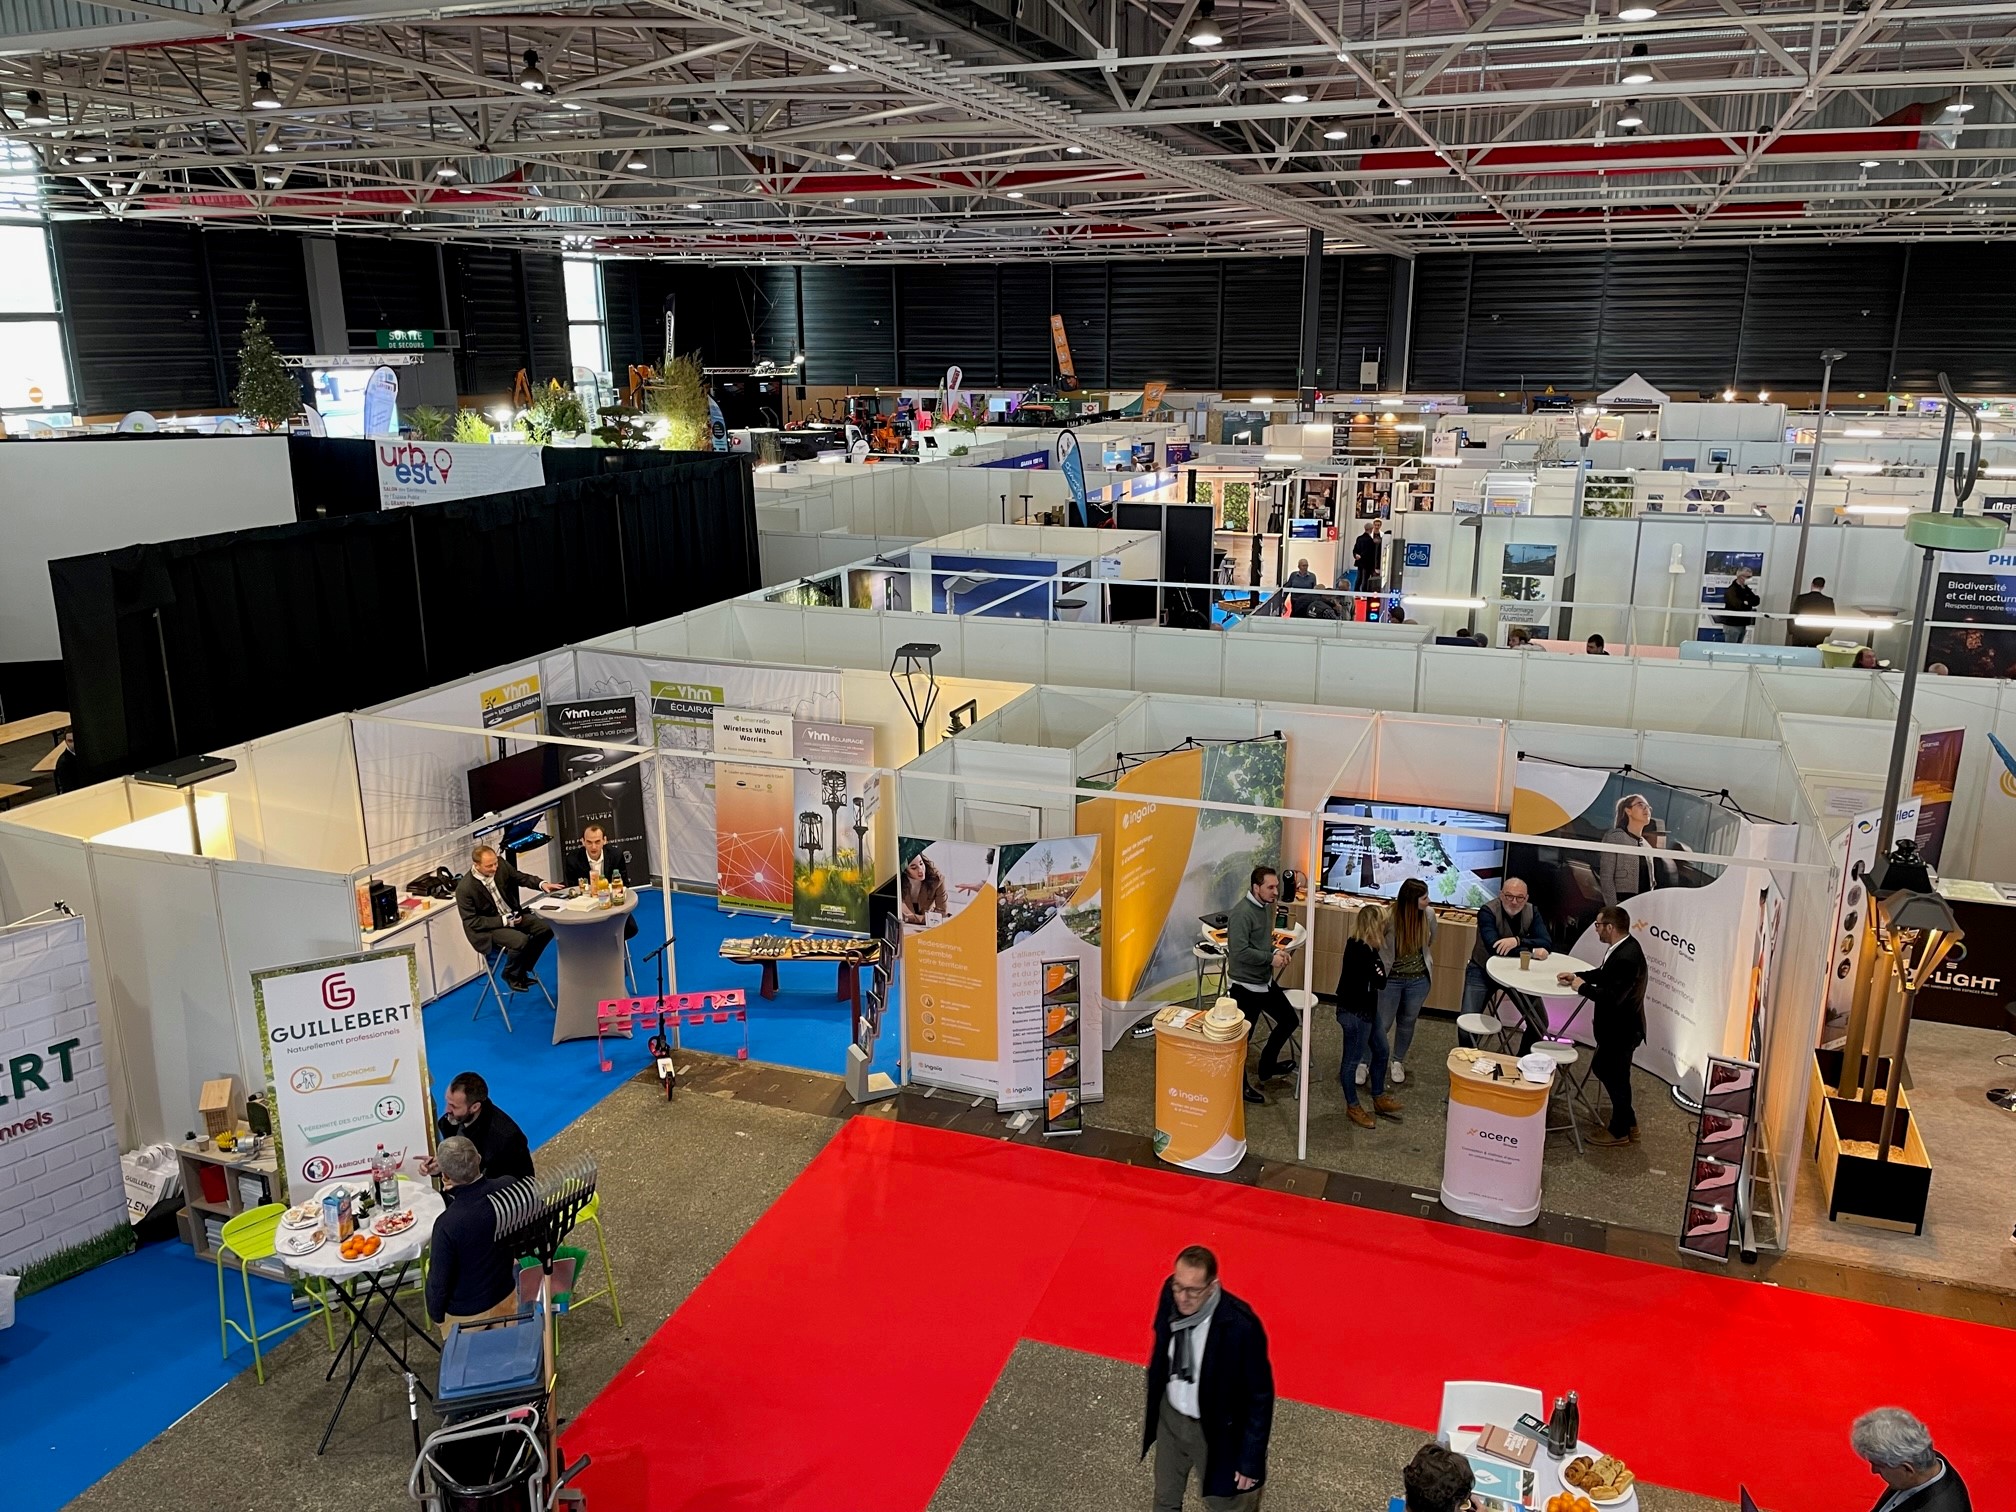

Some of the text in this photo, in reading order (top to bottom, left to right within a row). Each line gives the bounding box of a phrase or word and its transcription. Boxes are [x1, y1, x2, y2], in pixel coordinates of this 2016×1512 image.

[389, 331, 423, 341] SORTIE
[380, 442, 427, 467] urb
[395, 463, 437, 485] est
[1948, 580, 2007, 592] Biodiversité
[1946, 592, 1957, 600] et
[1959, 593, 1976, 601] ciel
[1945, 602, 1985, 610] Respectons
[502, 681, 531, 699] vhm
[677, 685, 712, 701] vhm
[498, 696, 540, 715] MOBILIER URBAIN
[564, 707, 627, 719] vhm ÉCLAIRAGE
[723, 724, 783, 736] Wireless Without
[740, 734, 767, 744] Worries
[807, 730, 864, 745] vhm ÉCLAIRAGE
[918, 938, 962, 952] Redessinons
[1650, 925, 1696, 955] acere
[918, 948, 953, 960] ensemble
[1011, 949, 1046, 959] L'alliance
[1678, 950, 1695, 962] Groupe
[918, 957, 968, 972] votre territoire
[1011, 960, 1031, 969] de la
[1646, 955, 1667, 968] ception
[1012, 969, 1032, 978] et du
[1012, 989, 1032, 998] votre
[270, 1003, 411, 1043] GUILLEBERT
[287, 1028, 401, 1054] Naturellement professionnels
[332, 1065, 376, 1080] ERGONOMIE
[304, 1113, 375, 1133] PÉRENNITÉ DES OUTILS
[1479, 1130, 1518, 1145] acere
[334, 1157, 366, 1170] FABRIQUÉ
[125, 1175, 156, 1190] GUILLEBERT
